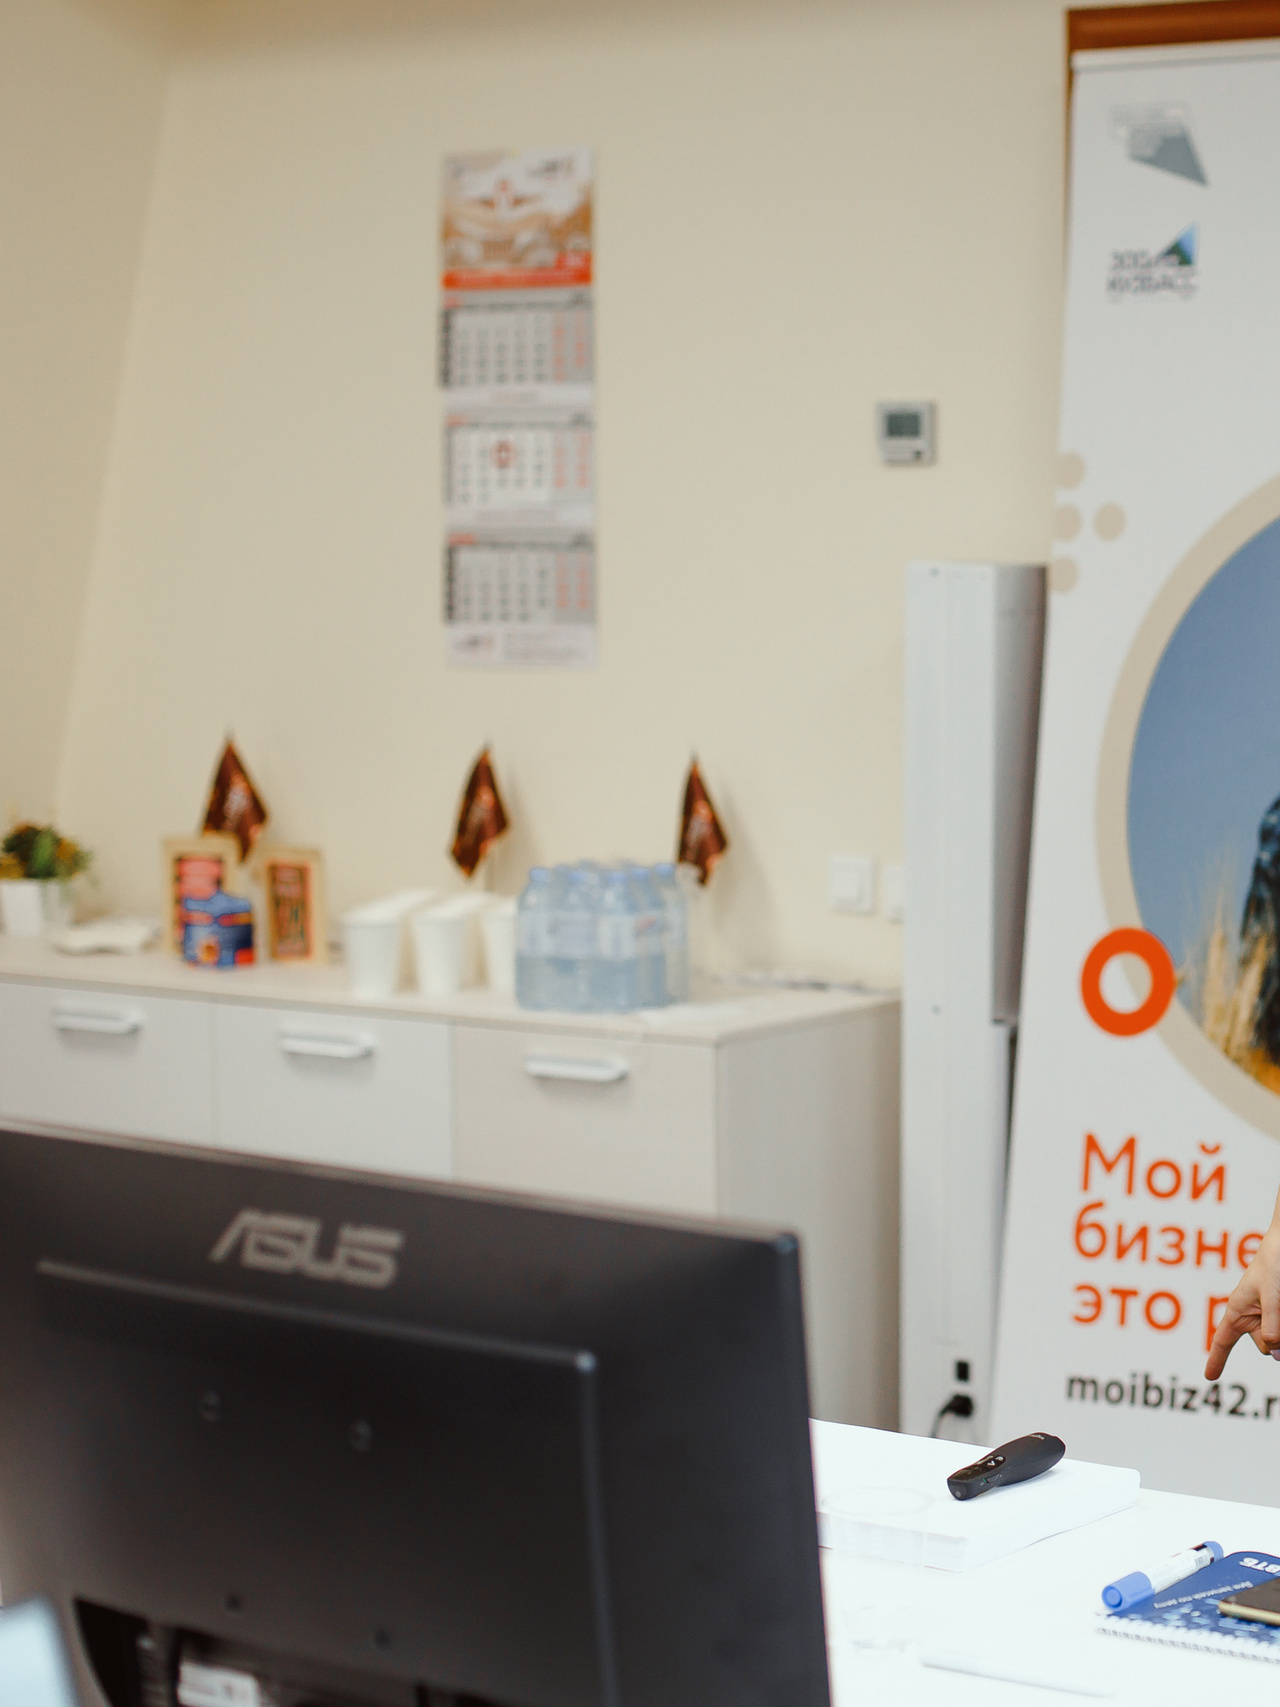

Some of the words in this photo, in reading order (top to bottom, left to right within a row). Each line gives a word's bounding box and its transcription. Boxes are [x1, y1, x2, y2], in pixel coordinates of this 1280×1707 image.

[1082, 1132, 1225, 1202] Мой
[207, 1208, 406, 1290] ASUS
[1074, 1201, 1266, 1269] бизне
[1072, 1284, 1182, 1331] это
